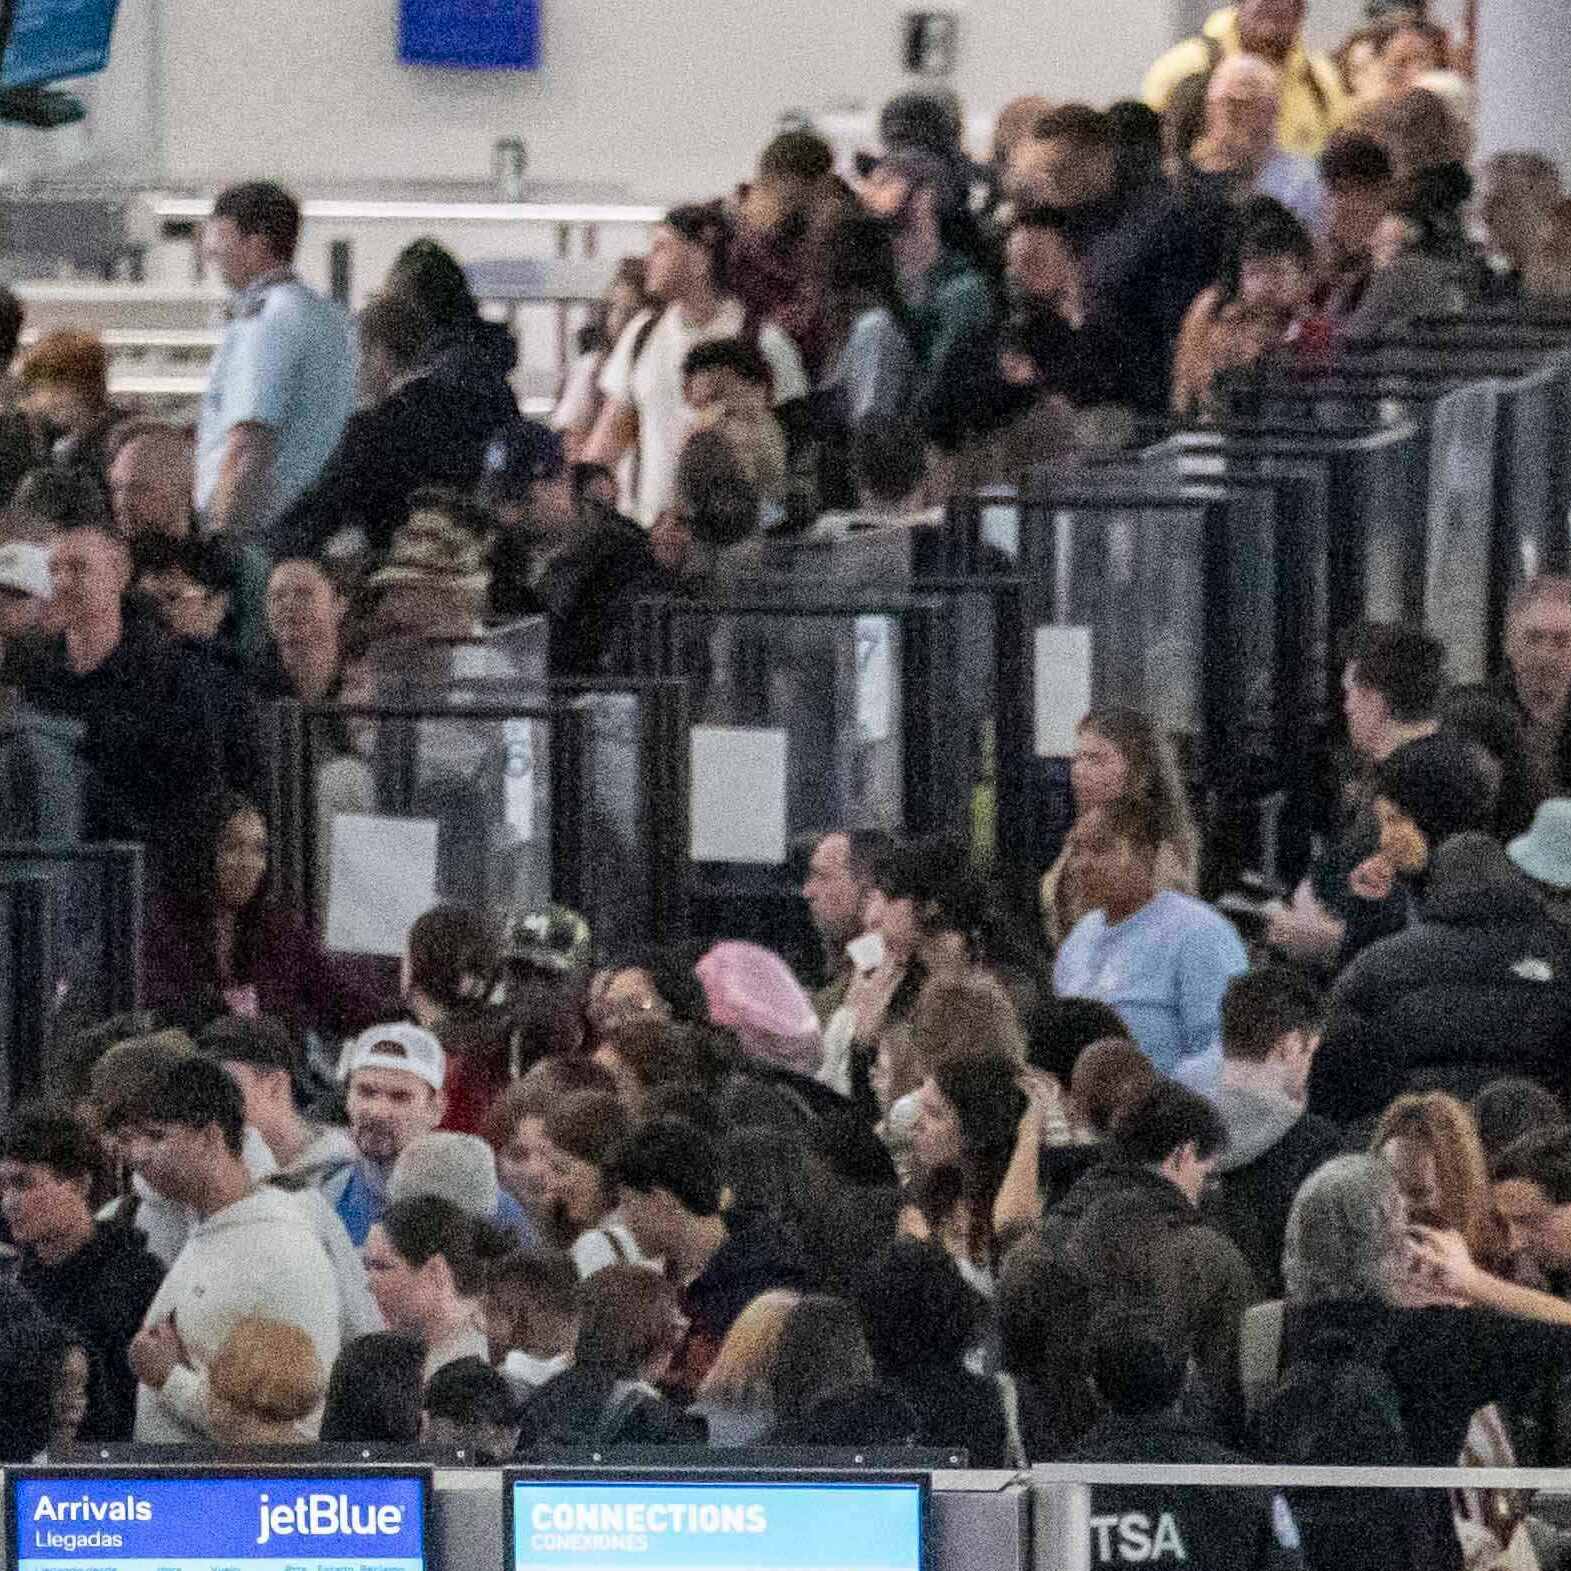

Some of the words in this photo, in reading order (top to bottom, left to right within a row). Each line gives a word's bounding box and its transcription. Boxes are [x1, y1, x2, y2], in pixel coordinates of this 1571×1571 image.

[34, 1495, 152, 1522] Arrivals
[257, 1494, 402, 1544] jetBlue
[532, 1503, 767, 1534] CONNECTIONS
[35, 1531, 123, 1549] Llegadas
[531, 1535, 649, 1552] CONEXIONES
[1089, 1512, 1186, 1562] TSA
